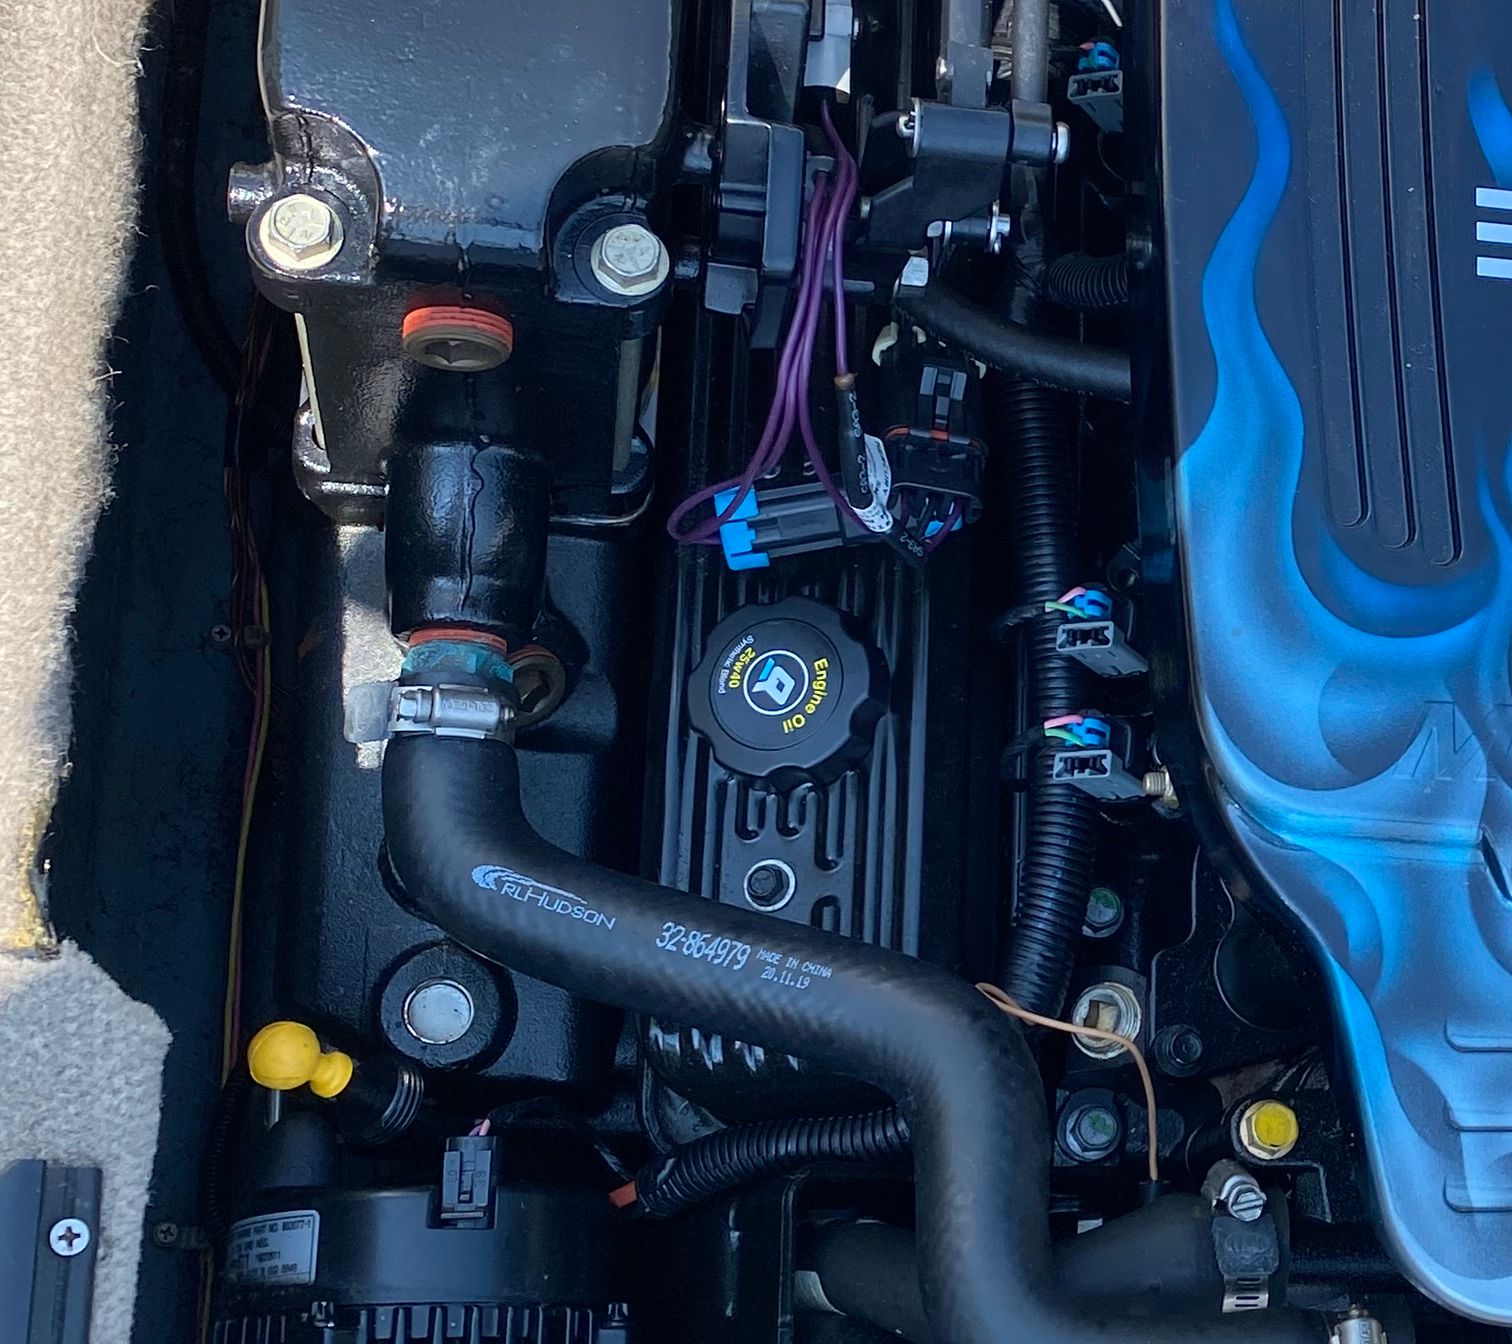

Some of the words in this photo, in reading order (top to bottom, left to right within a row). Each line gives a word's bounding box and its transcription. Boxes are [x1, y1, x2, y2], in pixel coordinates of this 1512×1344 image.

[723, 635, 755, 670] Synthetic
[717, 669, 732, 695] Blend
[803, 657, 829, 714] Engine
[782, 713, 806, 733] Oil
[655, 921, 752, 971] 32-864979
[756, 948, 782, 965] MADE
[784, 955, 798, 968] IN
[800, 960, 833, 979] CHINA
[760, 965, 811, 990] 20.11.19
